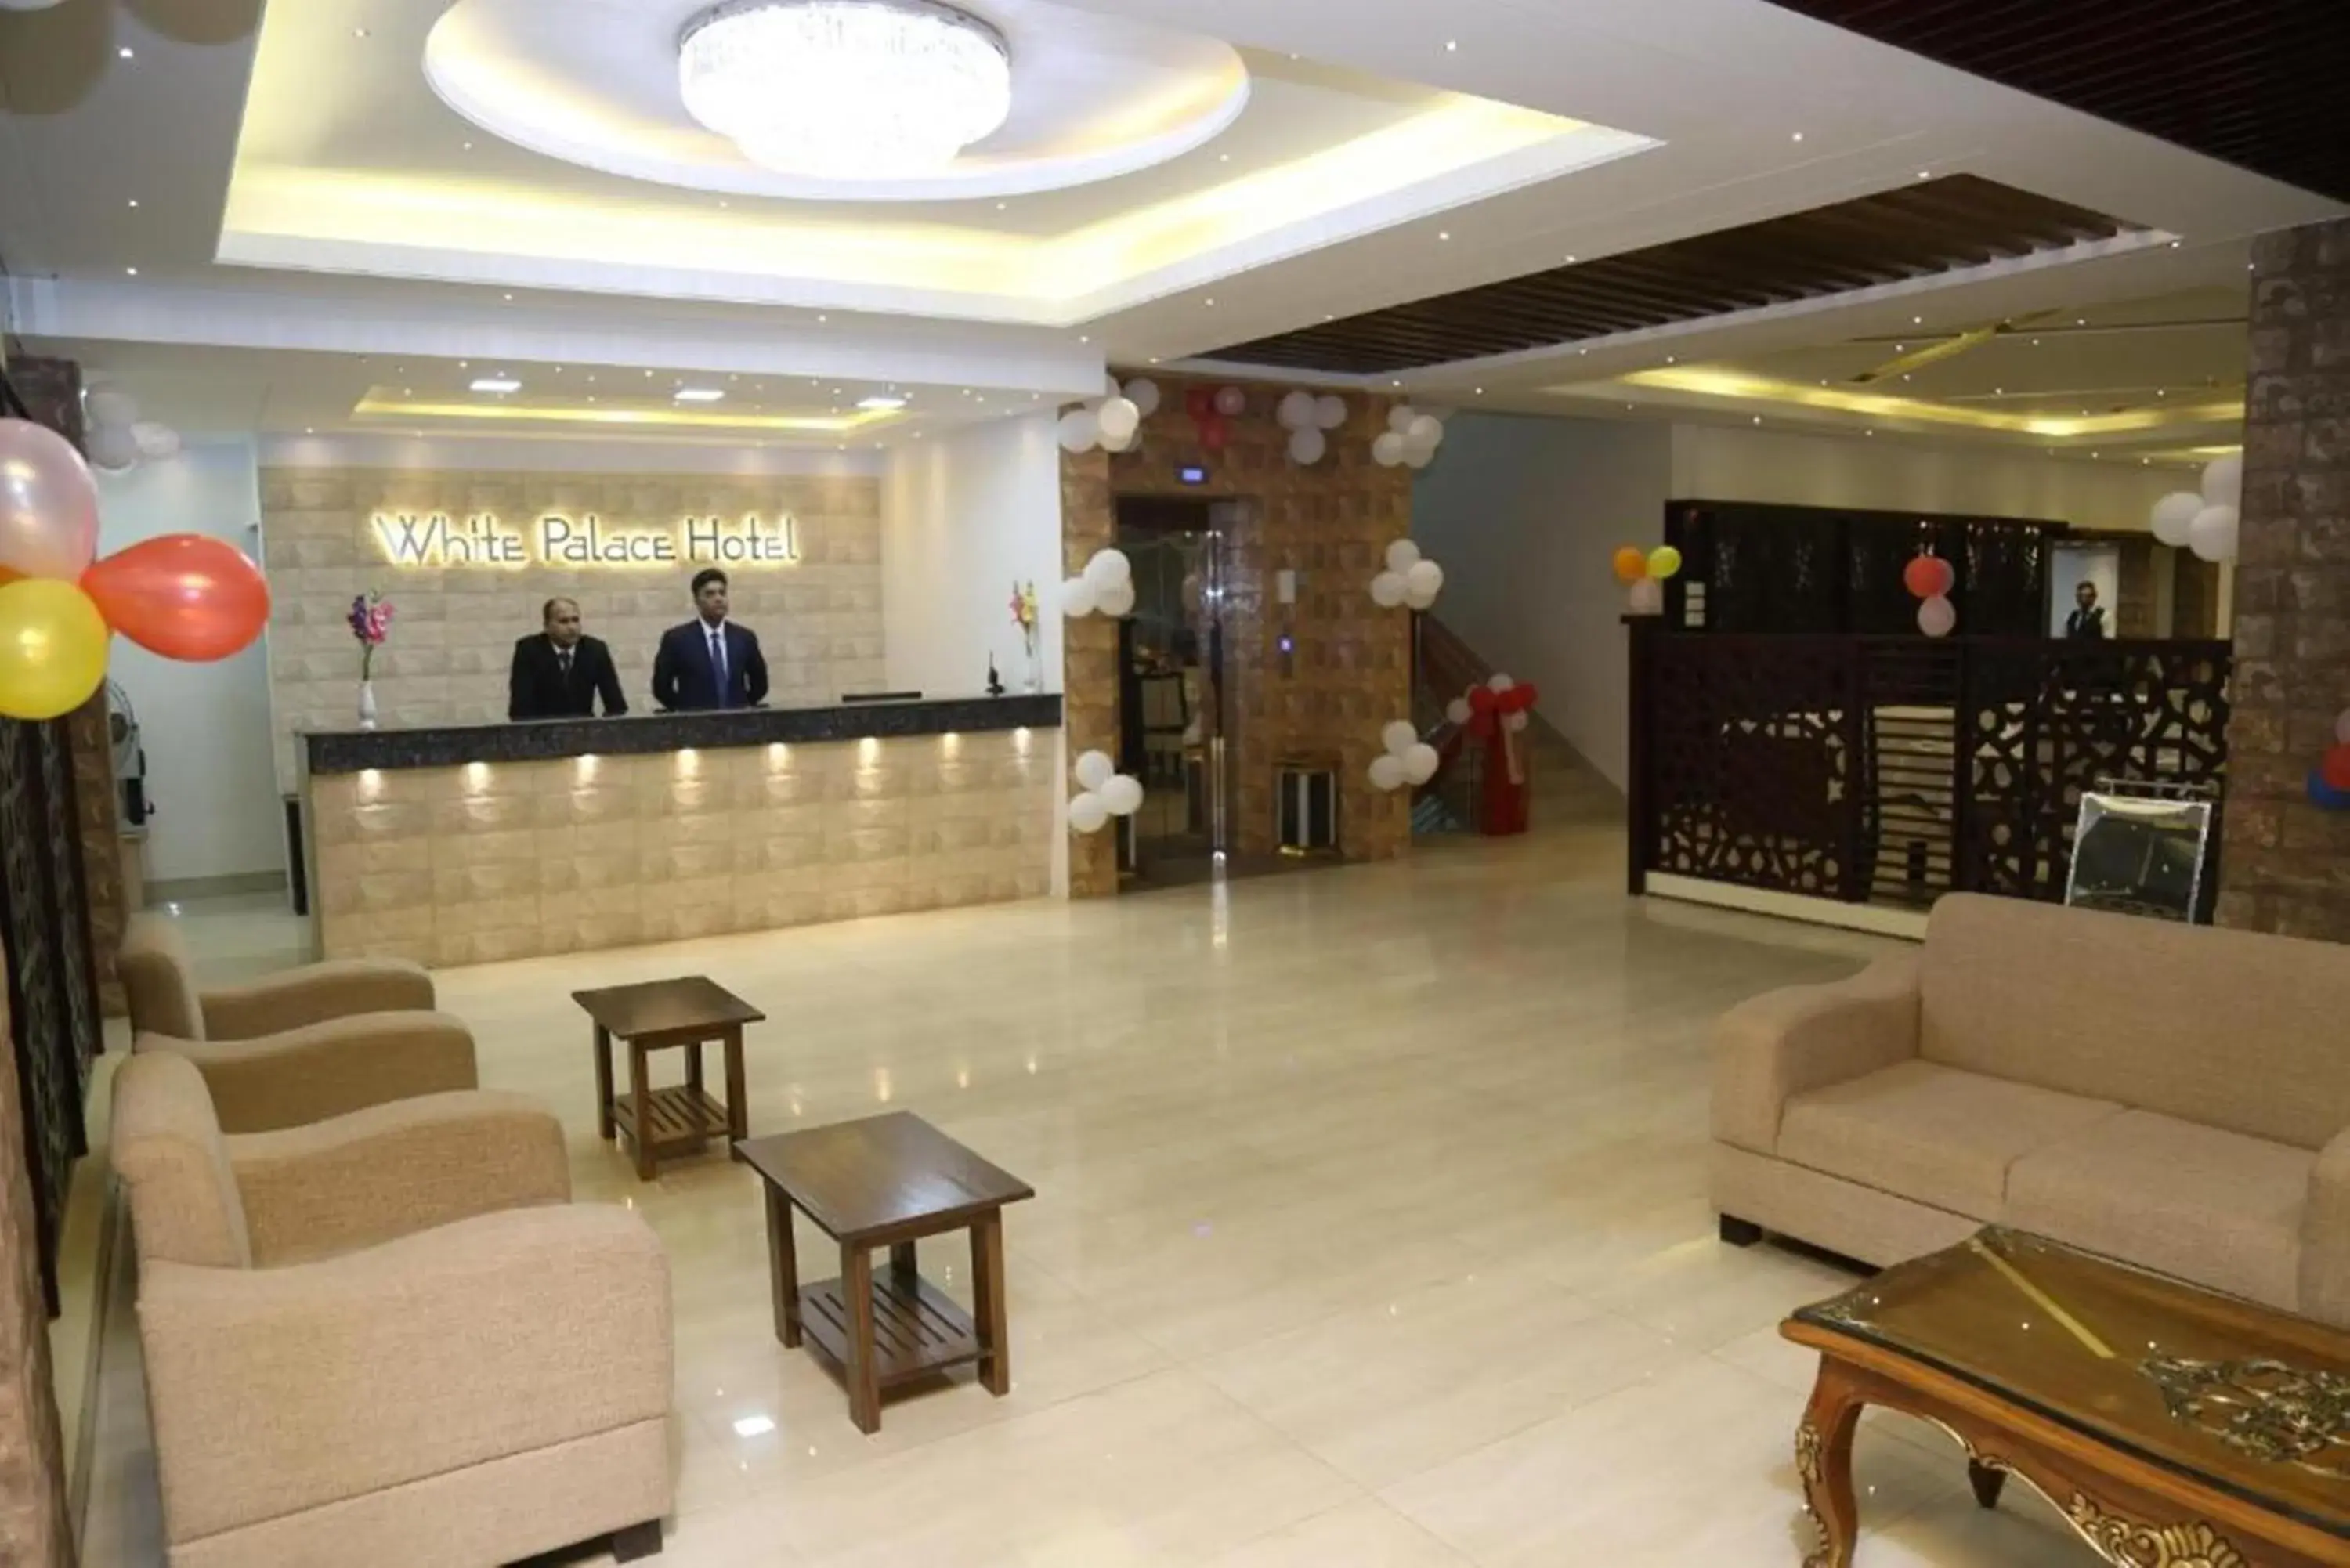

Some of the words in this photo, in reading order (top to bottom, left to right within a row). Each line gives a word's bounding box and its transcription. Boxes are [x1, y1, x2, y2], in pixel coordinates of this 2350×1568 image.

[375, 515, 526, 565] White
[543, 515, 677, 562] Palace
[687, 516, 798, 561] Hotel
